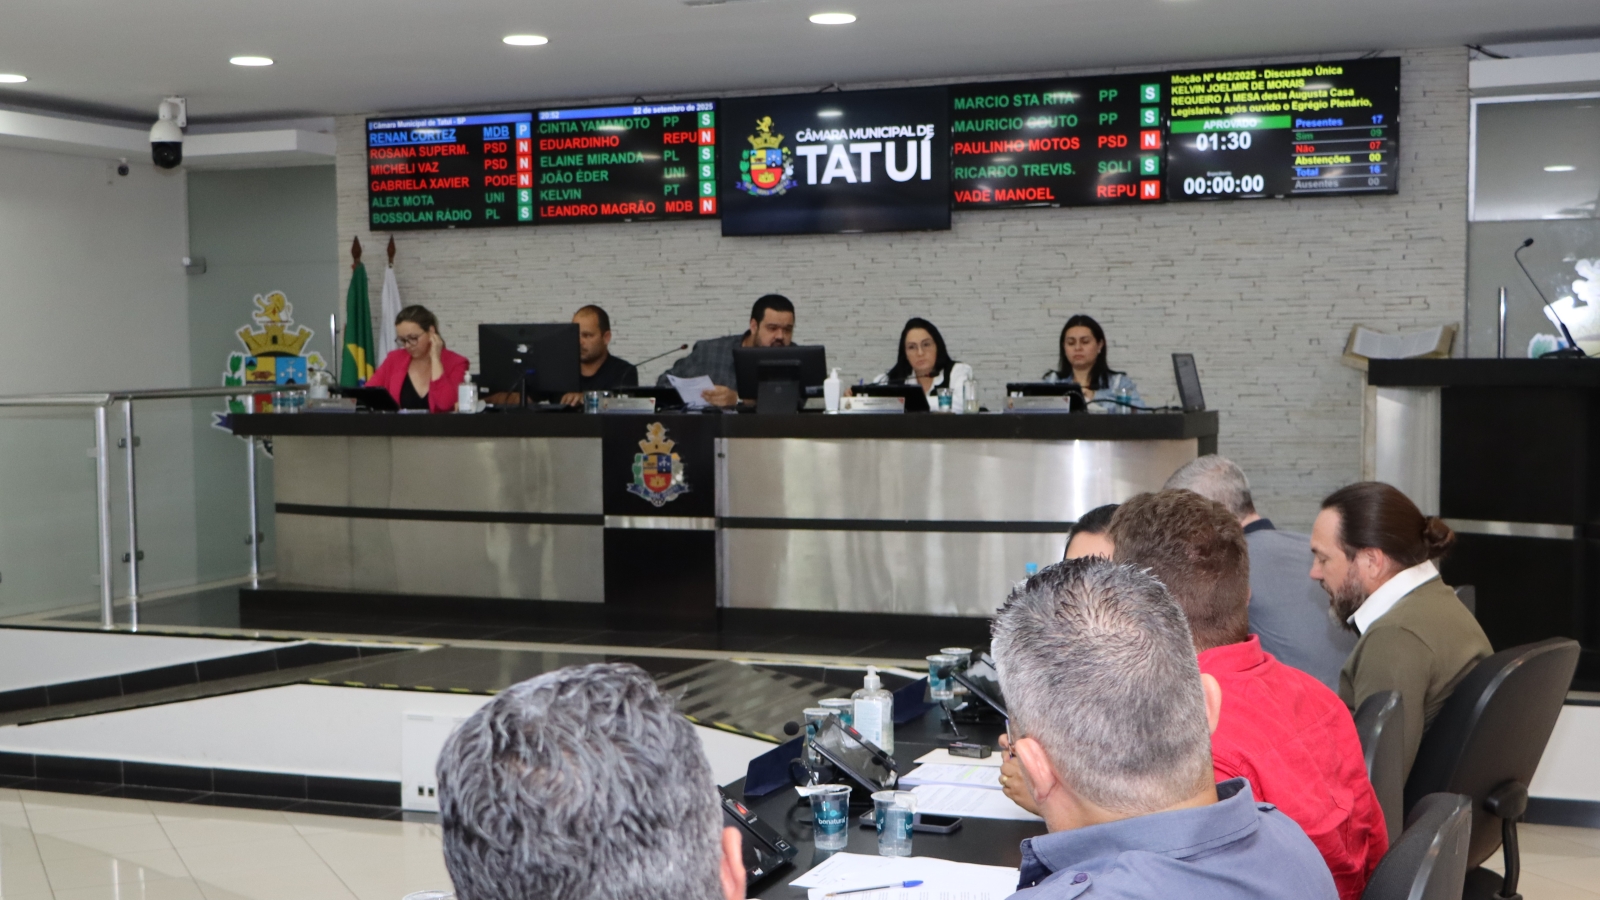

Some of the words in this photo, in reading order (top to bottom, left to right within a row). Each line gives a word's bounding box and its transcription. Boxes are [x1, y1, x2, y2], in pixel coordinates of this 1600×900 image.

[1171, 74, 1201, 84] Moção
[1216, 70, 1256, 81] 642/2025
[1264, 67, 1313, 79] Discussão
[1316, 65, 1343, 76] Única
[1145, 87, 1155, 99] S
[1171, 85, 1205, 95] KELVIN
[1207, 82, 1249, 93] JOELMIR
[1251, 82, 1264, 91] DE
[1266, 79, 1305, 90] MORAIS
[954, 95, 1009, 110] MARCIO
[1014, 94, 1040, 107] STA
[1044, 92, 1074, 104] RITA
[1100, 90, 1118, 102] PP
[1171, 95, 1221, 106] REQUEIRO
[1232, 93, 1259, 102] MESA
[1261, 91, 1287, 100] desta
[1289, 89, 1328, 101] Augusta
[1330, 88, 1354, 97] Casa
[653, 104, 684, 113] setembro
[697, 103, 713, 111] 2025
[1171, 106, 1223, 118] Legislativa,
[1225, 105, 1247, 115] após
[1249, 102, 1281, 112] ouvido
[1283, 103, 1289, 111] o
[1292, 100, 1328, 112] Egrégio
[1330, 97, 1372, 108] Plenário,
[663, 116, 679, 127] PP
[702, 114, 710, 125] S
[1100, 113, 1118, 125] PP
[1145, 111, 1155, 123] S
[1295, 117, 1343, 129] Presentes
[1372, 115, 1383, 124] 17
[398, 120, 427, 128] Municipal
[539, 122, 578, 134] CINTIA
[581, 118, 650, 131] YAMAMOTO
[954, 118, 1023, 132] MAURICIO
[1027, 115, 1078, 129] COUTO
[1203, 118, 1257, 129] APROVADO
[370, 132, 407, 143] RENAN
[410, 128, 456, 142] CORTEZ
[483, 126, 509, 138] MDB
[519, 125, 527, 135] P
[796, 128, 848, 142] CÂMARA
[850, 126, 916, 140] MUNICIPAL
[917, 124, 934, 136] DE
[1295, 131, 1313, 141] Sim
[1370, 128, 1382, 137] 09
[664, 132, 697, 144] REPU
[702, 131, 710, 142] N
[1098, 135, 1127, 148] PSD
[1145, 134, 1155, 147] N
[1196, 132, 1251, 151] 01:30
[484, 142, 507, 153] PSD
[520, 142, 528, 152] N
[540, 136, 619, 150] EDUARDINHO
[954, 140, 1024, 154] PAULINHO
[1028, 137, 1080, 151] MOTOS
[1295, 144, 1315, 153] Não
[1370, 141, 1381, 149] 07
[371, 147, 416, 159] ROSANA
[419, 145, 469, 157] SUPERM.
[664, 150, 679, 161] PL
[702, 148, 710, 160] S
[485, 159, 507, 170] PSD
[520, 158, 528, 169] N
[541, 155, 583, 167] ELAINE
[588, 152, 644, 165] MIRANDA
[796, 134, 934, 184] TATUÍ
[1145, 159, 1155, 171] S
[1295, 154, 1351, 166] Abstenções
[1369, 153, 1381, 162] 00
[371, 163, 415, 175] MICHELI
[418, 162, 439, 173] VAZ
[664, 167, 685, 178] UNI
[703, 165, 711, 177] S
[955, 165, 1018, 179] RICARDO
[1022, 163, 1075, 176] TREVIS.
[1098, 161, 1131, 173] SOLI
[1295, 167, 1319, 177] Total
[1369, 165, 1380, 174] 16
[485, 175, 516, 186] PODE
[521, 175, 528, 185] N
[540, 170, 572, 184] JOÃO
[576, 168, 608, 182] ÉDER
[372, 180, 427, 191] GABRIELA
[430, 177, 469, 189] XAVIER
[703, 183, 711, 194] S
[1184, 175, 1264, 195] 00:00:00
[1295, 178, 1339, 189] Ausentes
[1368, 177, 1379, 186] 00
[540, 189, 581, 200] KELVIN
[664, 184, 679, 195] PT
[954, 190, 990, 202] VADE
[995, 187, 1054, 201] MANOEL
[1097, 184, 1136, 197] REPU
[1145, 184, 1155, 196] N
[372, 197, 400, 207] ALEX
[403, 195, 434, 206] MOTA
[485, 192, 504, 203] UNI
[521, 191, 529, 202] S
[541, 204, 598, 217] LEANDRO
[601, 200, 656, 214] MAGRÃO
[666, 200, 693, 212] MDB
[703, 200, 712, 211] N
[373, 212, 433, 223] BOSSOLAN
[436, 208, 472, 221] RÁDIO
[486, 209, 500, 219] PL
[521, 207, 529, 218] S
